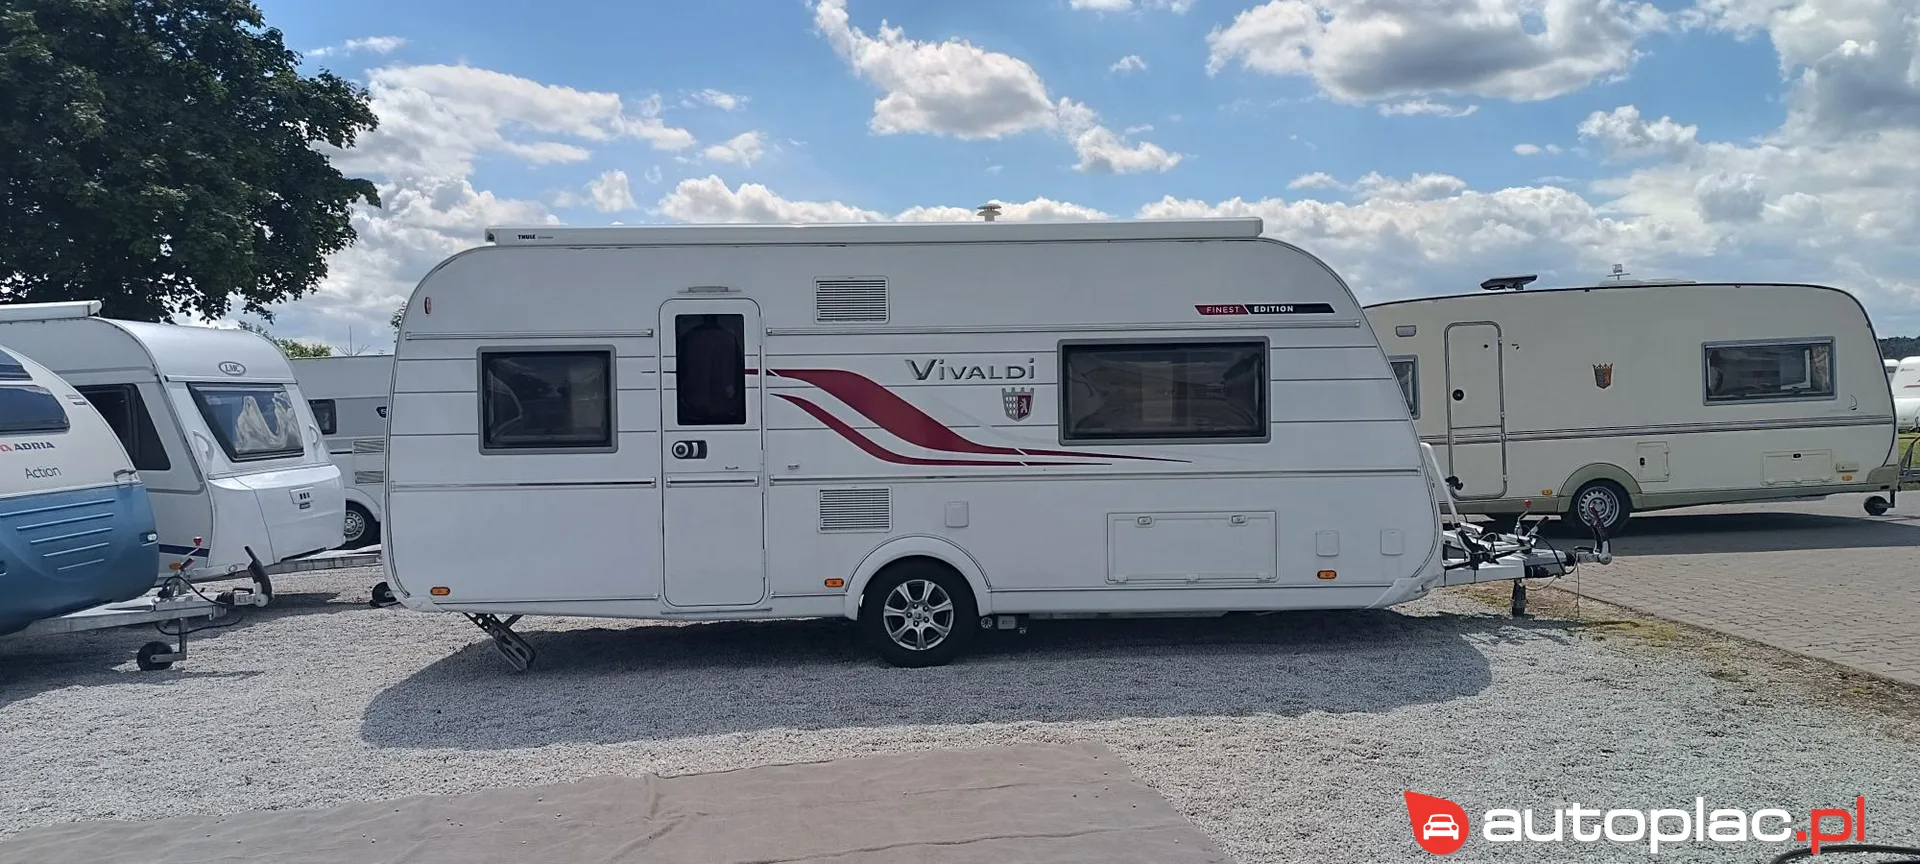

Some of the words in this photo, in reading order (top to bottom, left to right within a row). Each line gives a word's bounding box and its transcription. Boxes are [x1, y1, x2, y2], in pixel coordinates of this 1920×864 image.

[1206, 306, 1240, 314] FINEST
[1253, 305, 1294, 313] EDITION
[14, 441, 56, 452] ADRIA
[25, 465, 62, 479] Action
